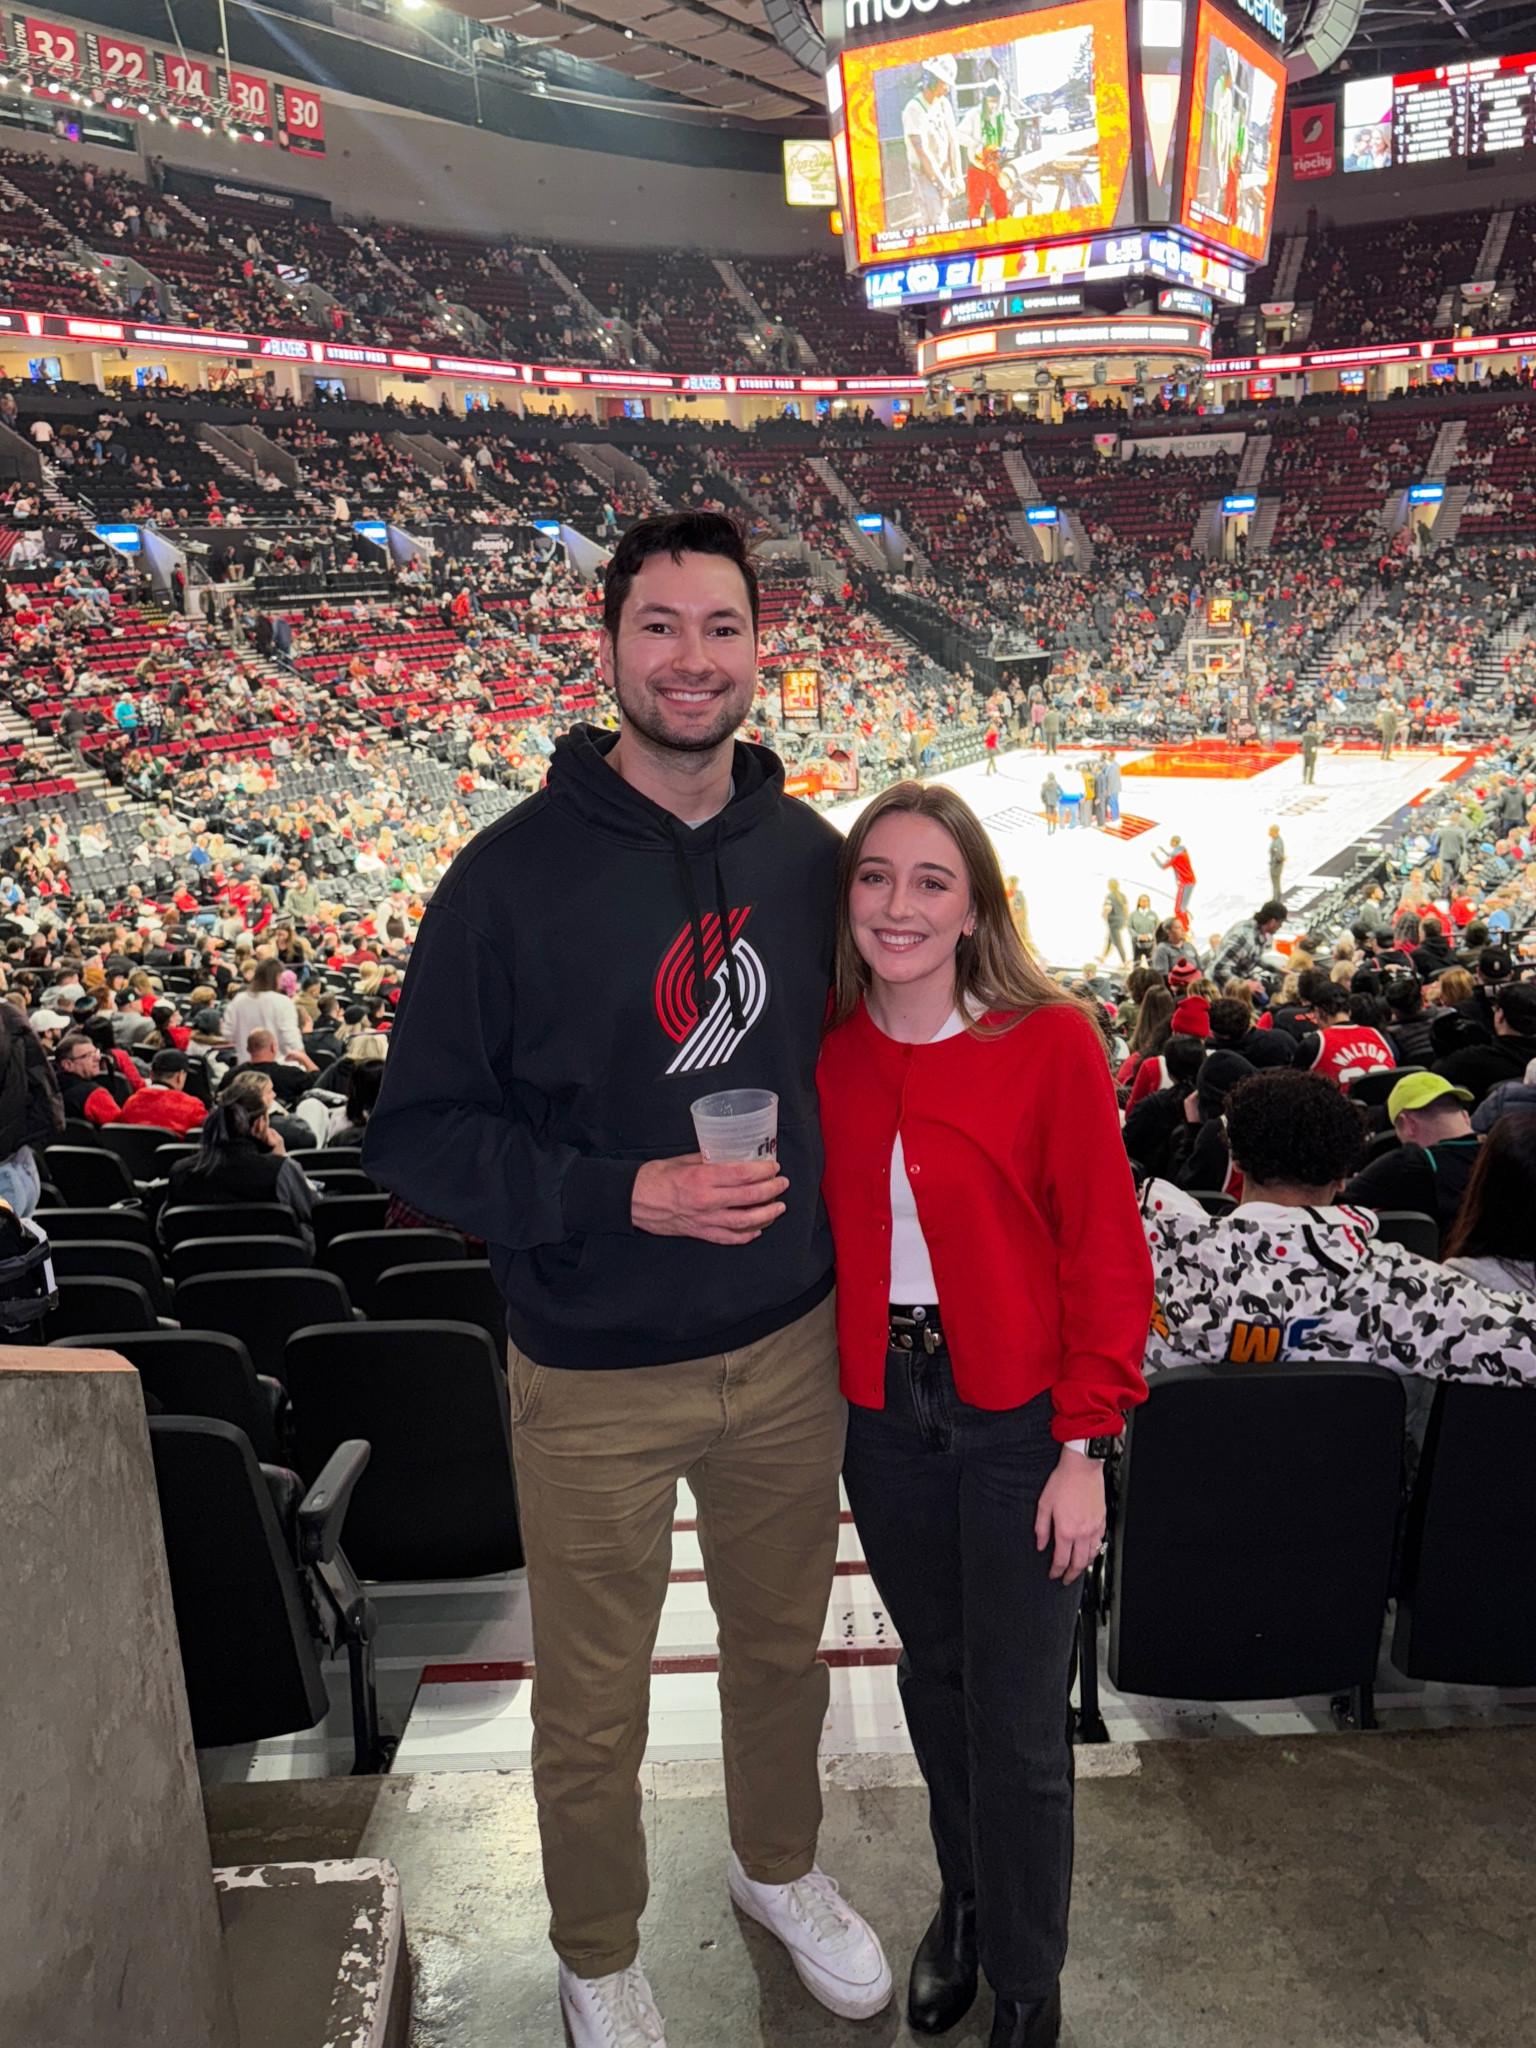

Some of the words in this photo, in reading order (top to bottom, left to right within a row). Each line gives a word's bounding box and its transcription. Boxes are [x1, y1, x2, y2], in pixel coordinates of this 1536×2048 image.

[846, 0, 972, 28] mo
[34, 30, 75, 72] 32
[106, 47, 143, 88] 22
[172, 65, 204, 98] 14
[235, 82, 265, 115] 30
[276, 93, 286, 122] GROSS
[290, 97, 319, 128] 30
[1211, 607, 1230, 622] 24
[788, 686, 814, 707] 24
[1331, 1042, 1387, 1067] WALTON
